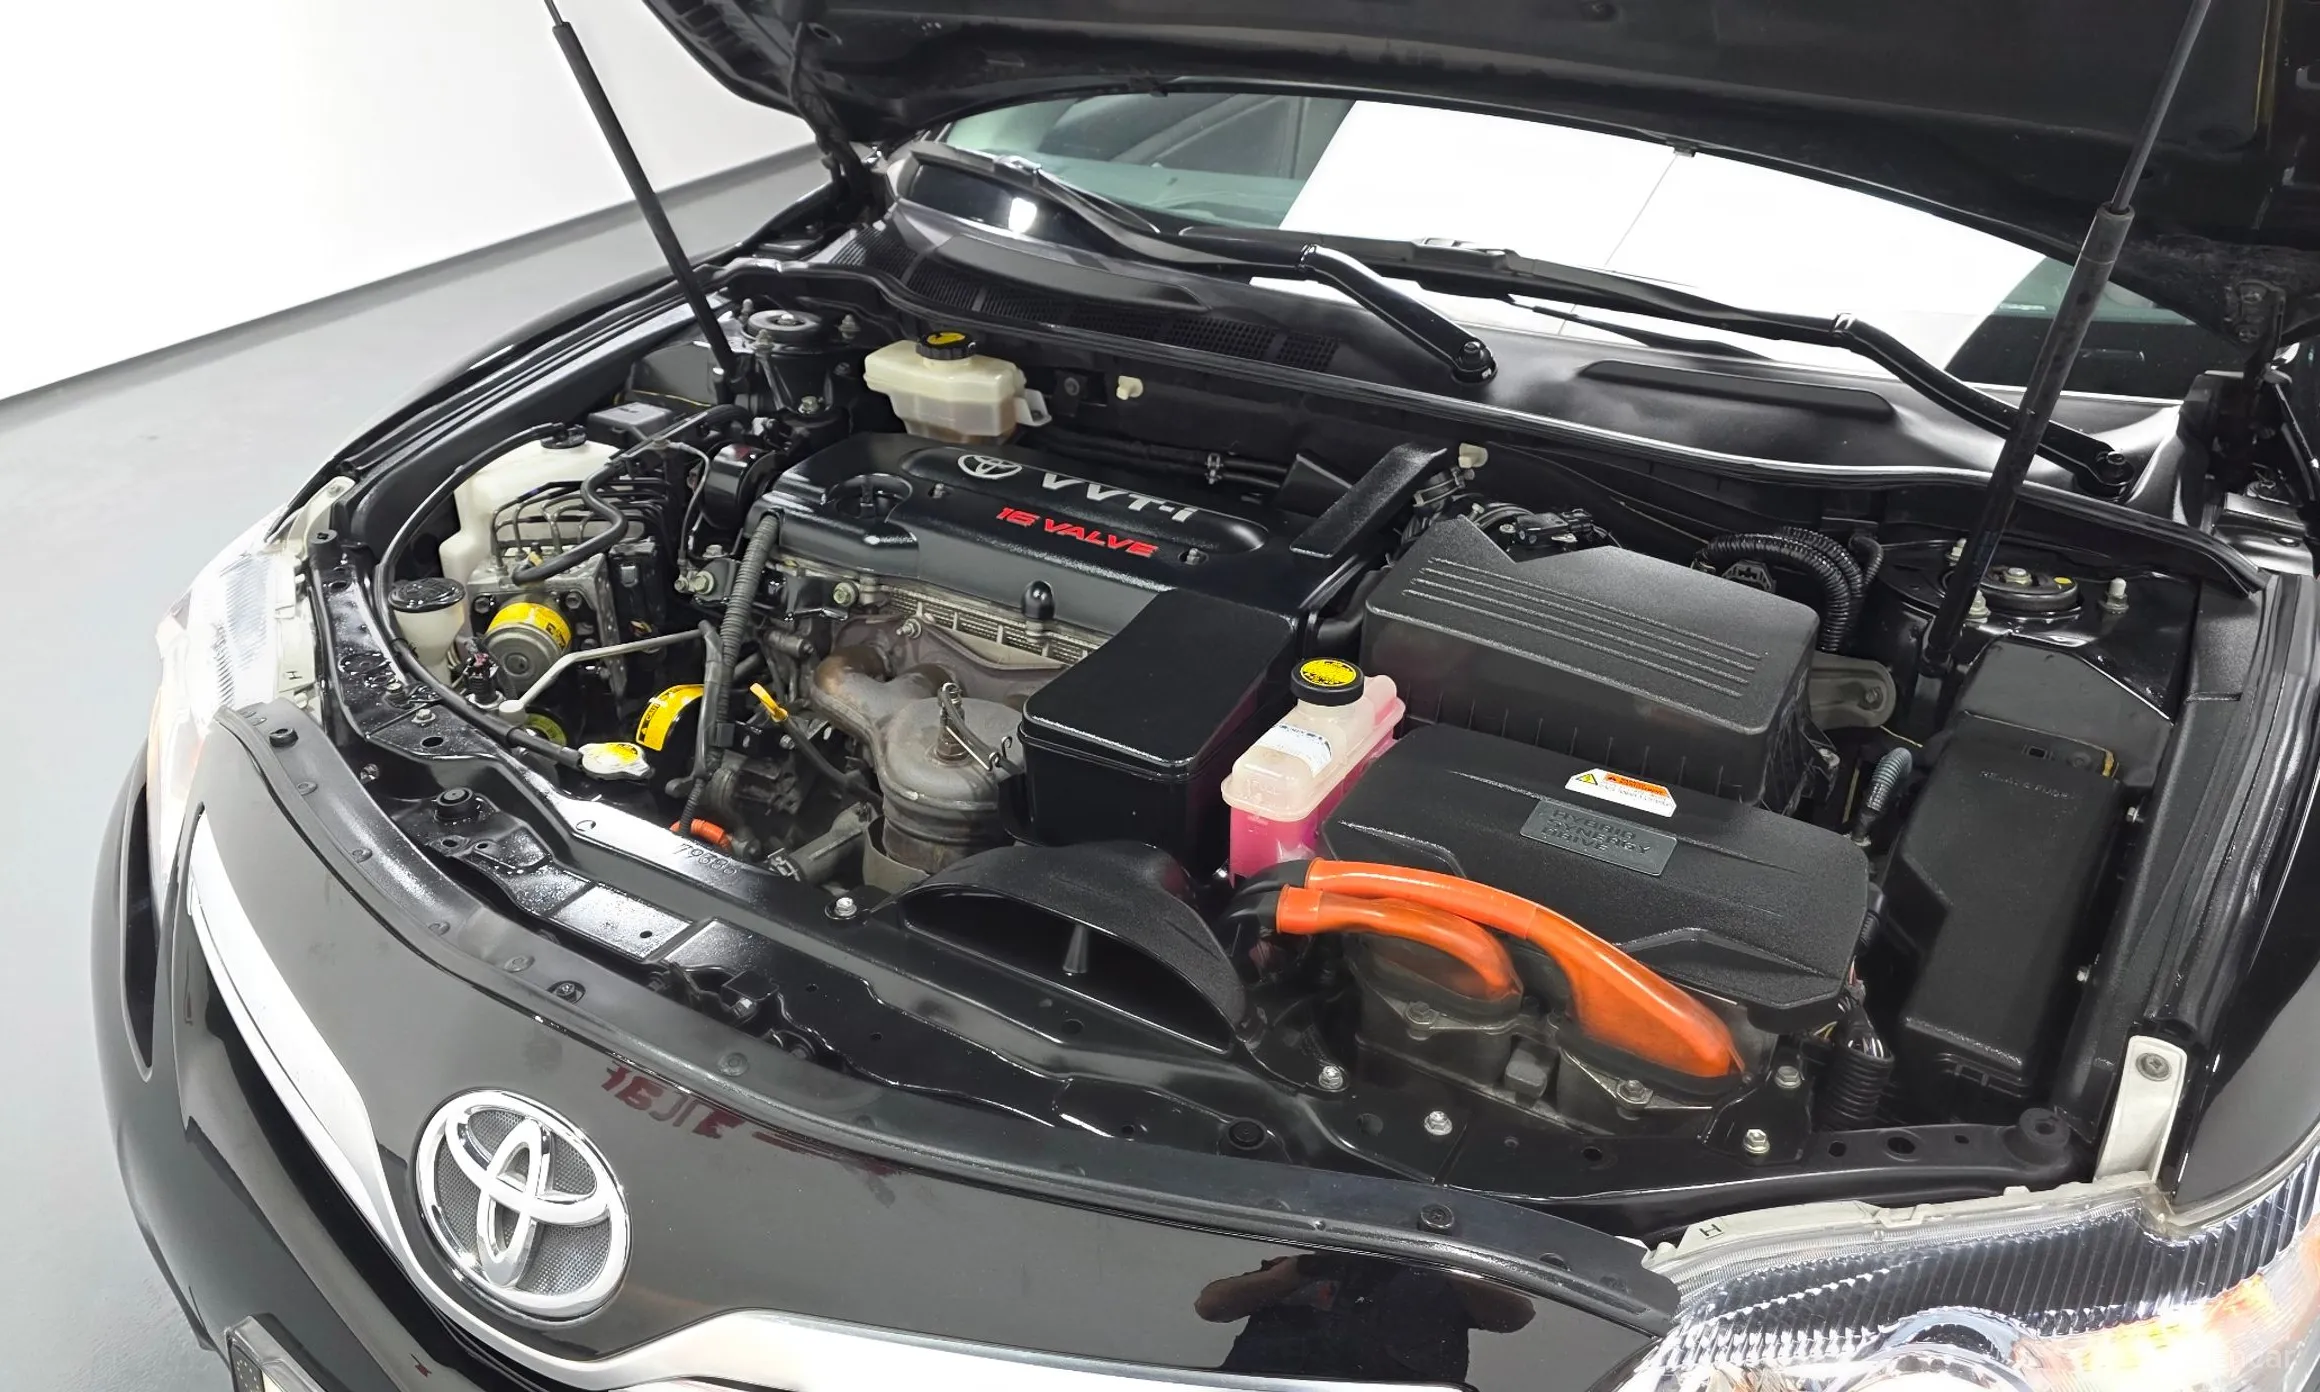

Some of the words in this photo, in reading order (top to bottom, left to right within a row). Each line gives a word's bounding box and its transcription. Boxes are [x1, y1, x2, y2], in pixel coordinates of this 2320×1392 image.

[996, 507, 1041, 528] 16
[1044, 517, 1159, 558] VALVE
[1541, 826, 1608, 853] DRIVE
[1546, 817, 1652, 854] SYNERGY
[1552, 809, 1636, 840] HYBRID
